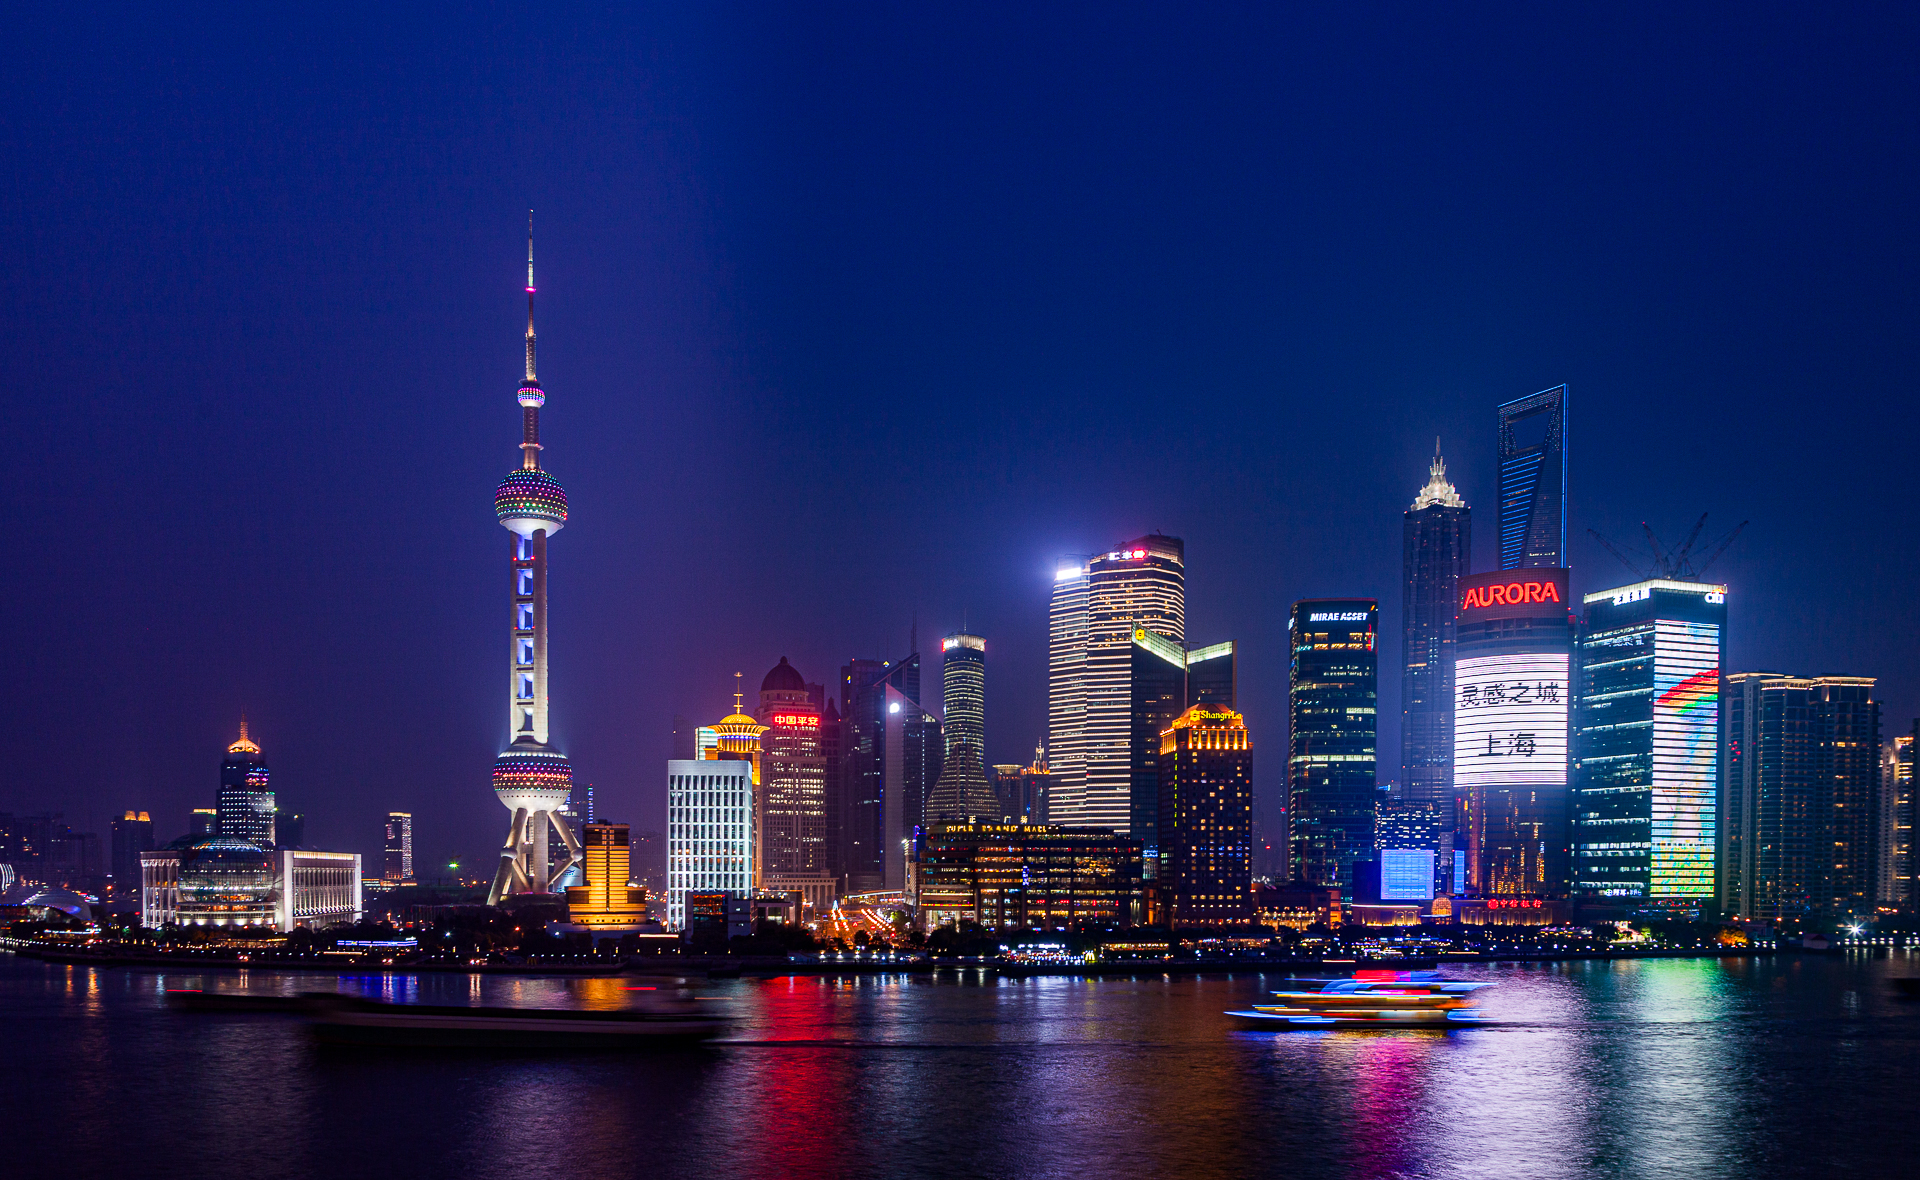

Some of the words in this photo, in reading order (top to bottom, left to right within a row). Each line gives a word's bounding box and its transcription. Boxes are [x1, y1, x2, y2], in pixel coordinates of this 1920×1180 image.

[1463, 581, 1560, 610] AURORA
[1309, 612, 1340, 622] MIRAE
[1340, 612, 1368, 621] ASSET
[1461, 682, 1560, 708] 灵感之城
[774, 714, 819, 726] 中国平安
[1478, 733, 1536, 758] 上海
